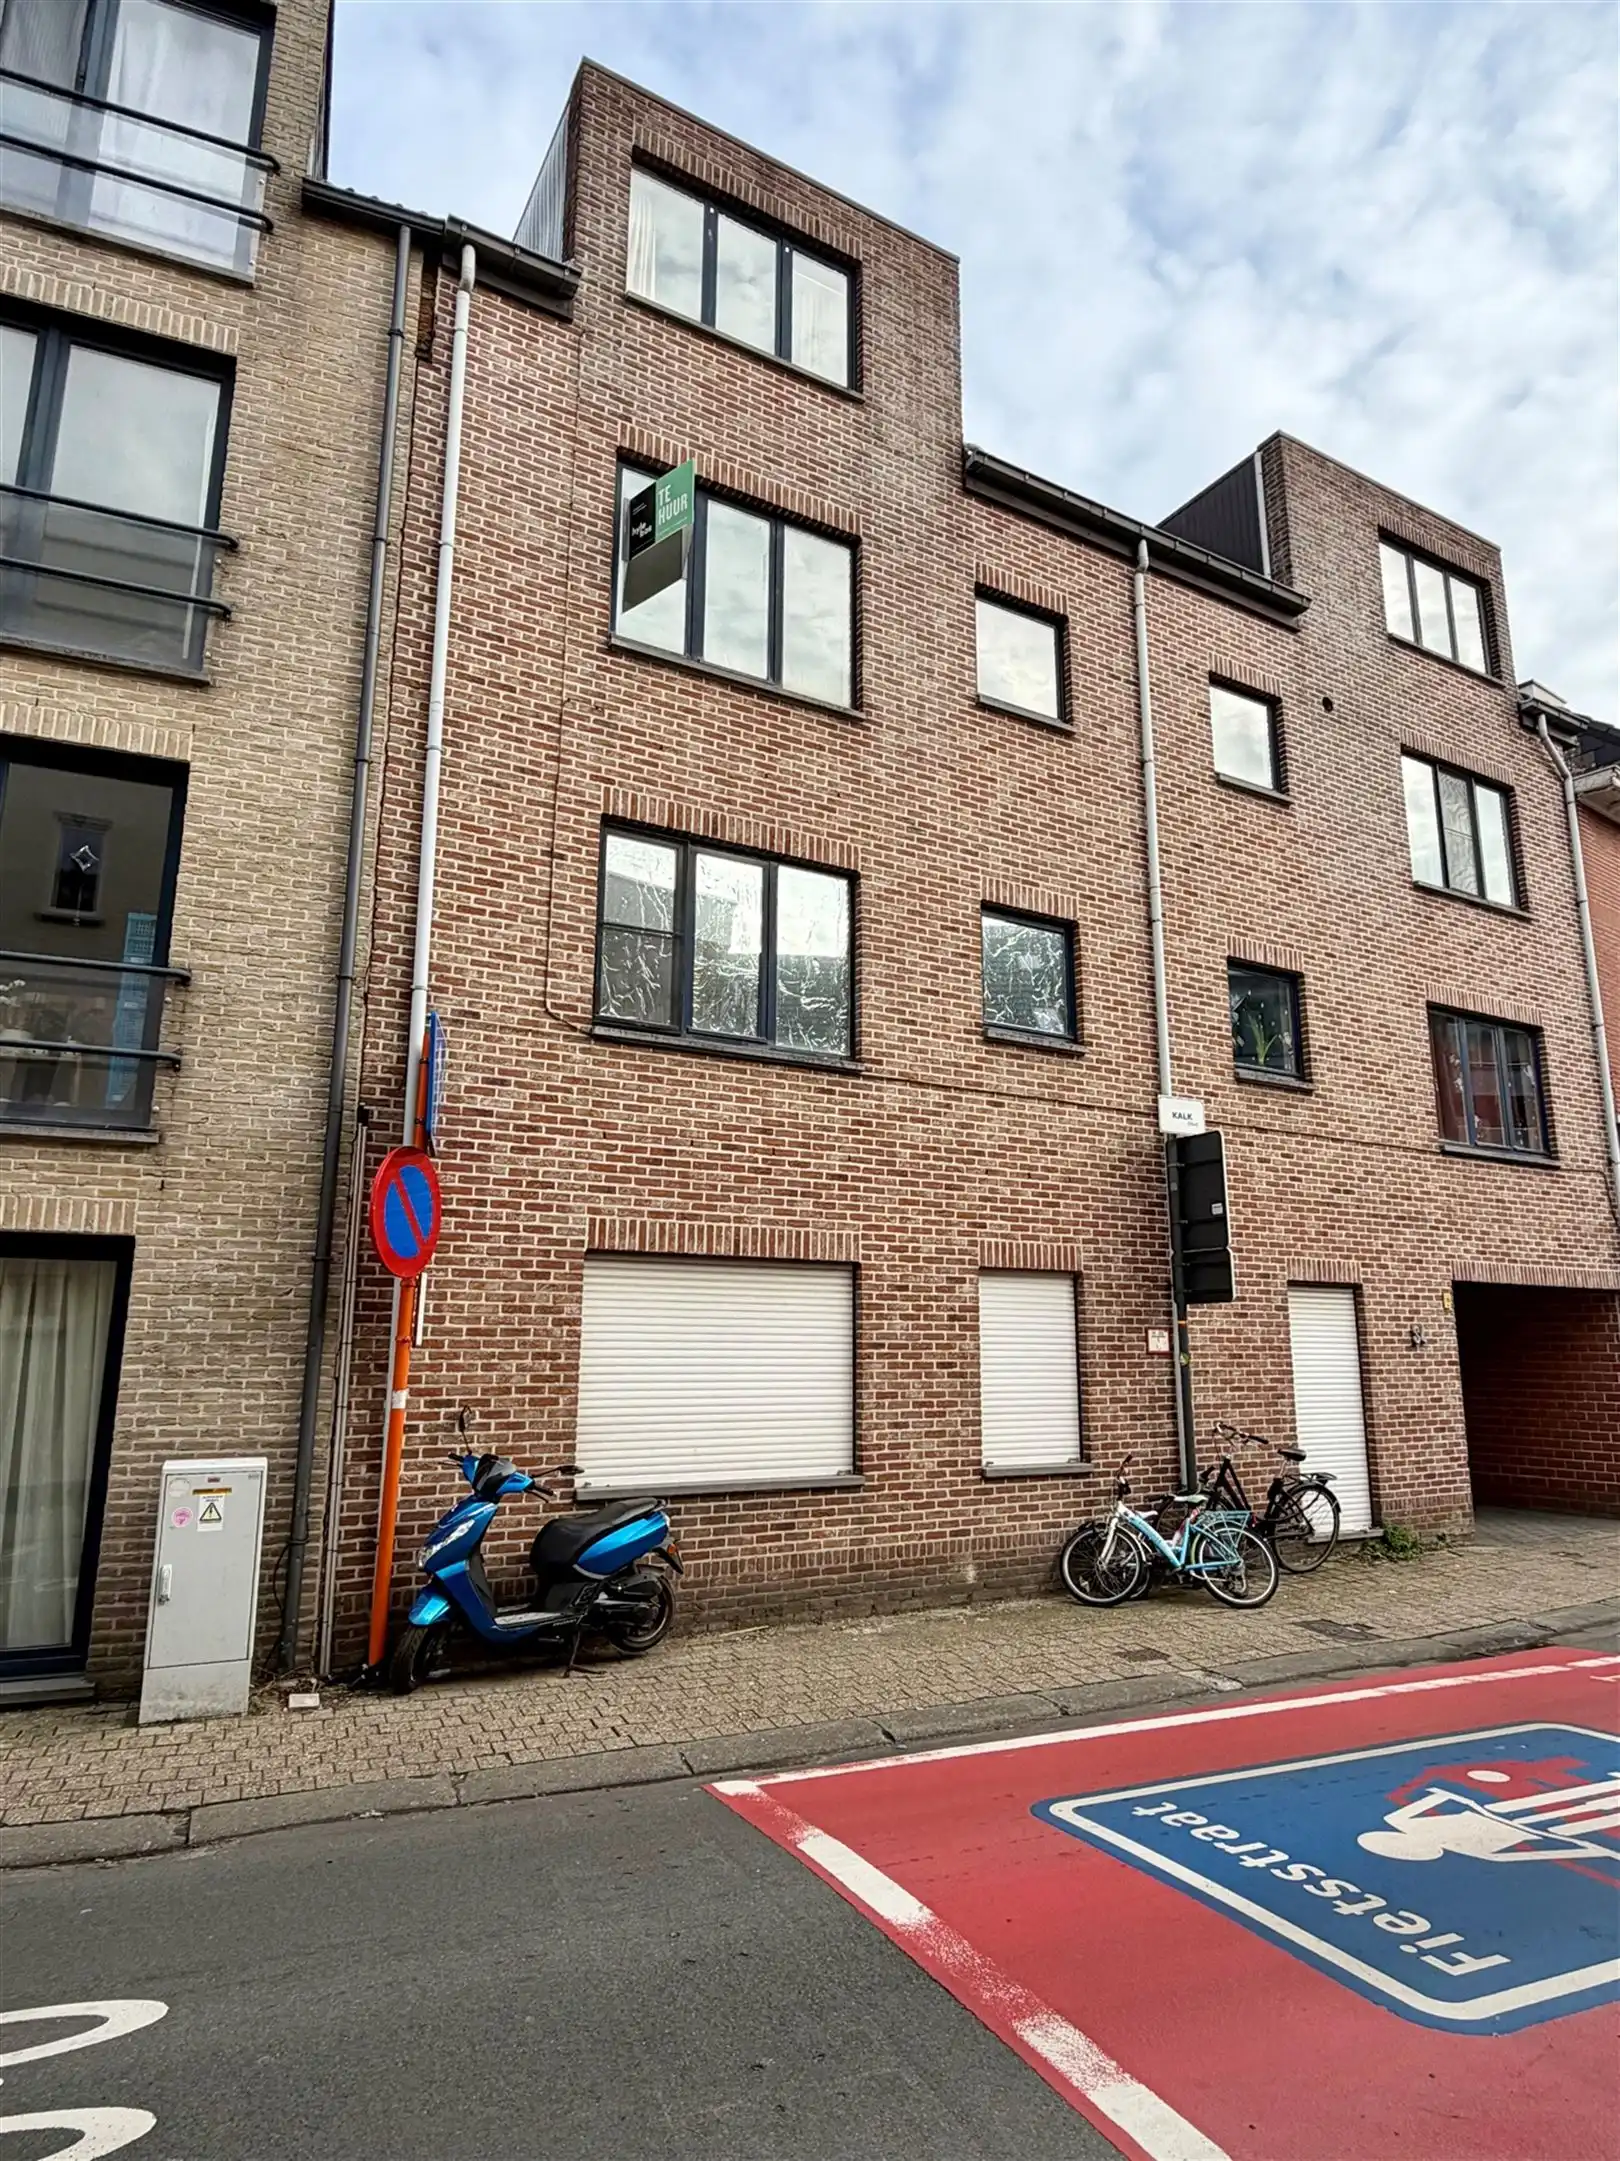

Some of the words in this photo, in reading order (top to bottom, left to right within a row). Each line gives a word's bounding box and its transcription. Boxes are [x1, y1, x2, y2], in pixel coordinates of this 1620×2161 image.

[658, 485, 671, 506] TE
[658, 493, 687, 525] HUUR
[1171, 1111, 1193, 1121] KALK
[1131, 1800, 1511, 1976] Fietsstraat
